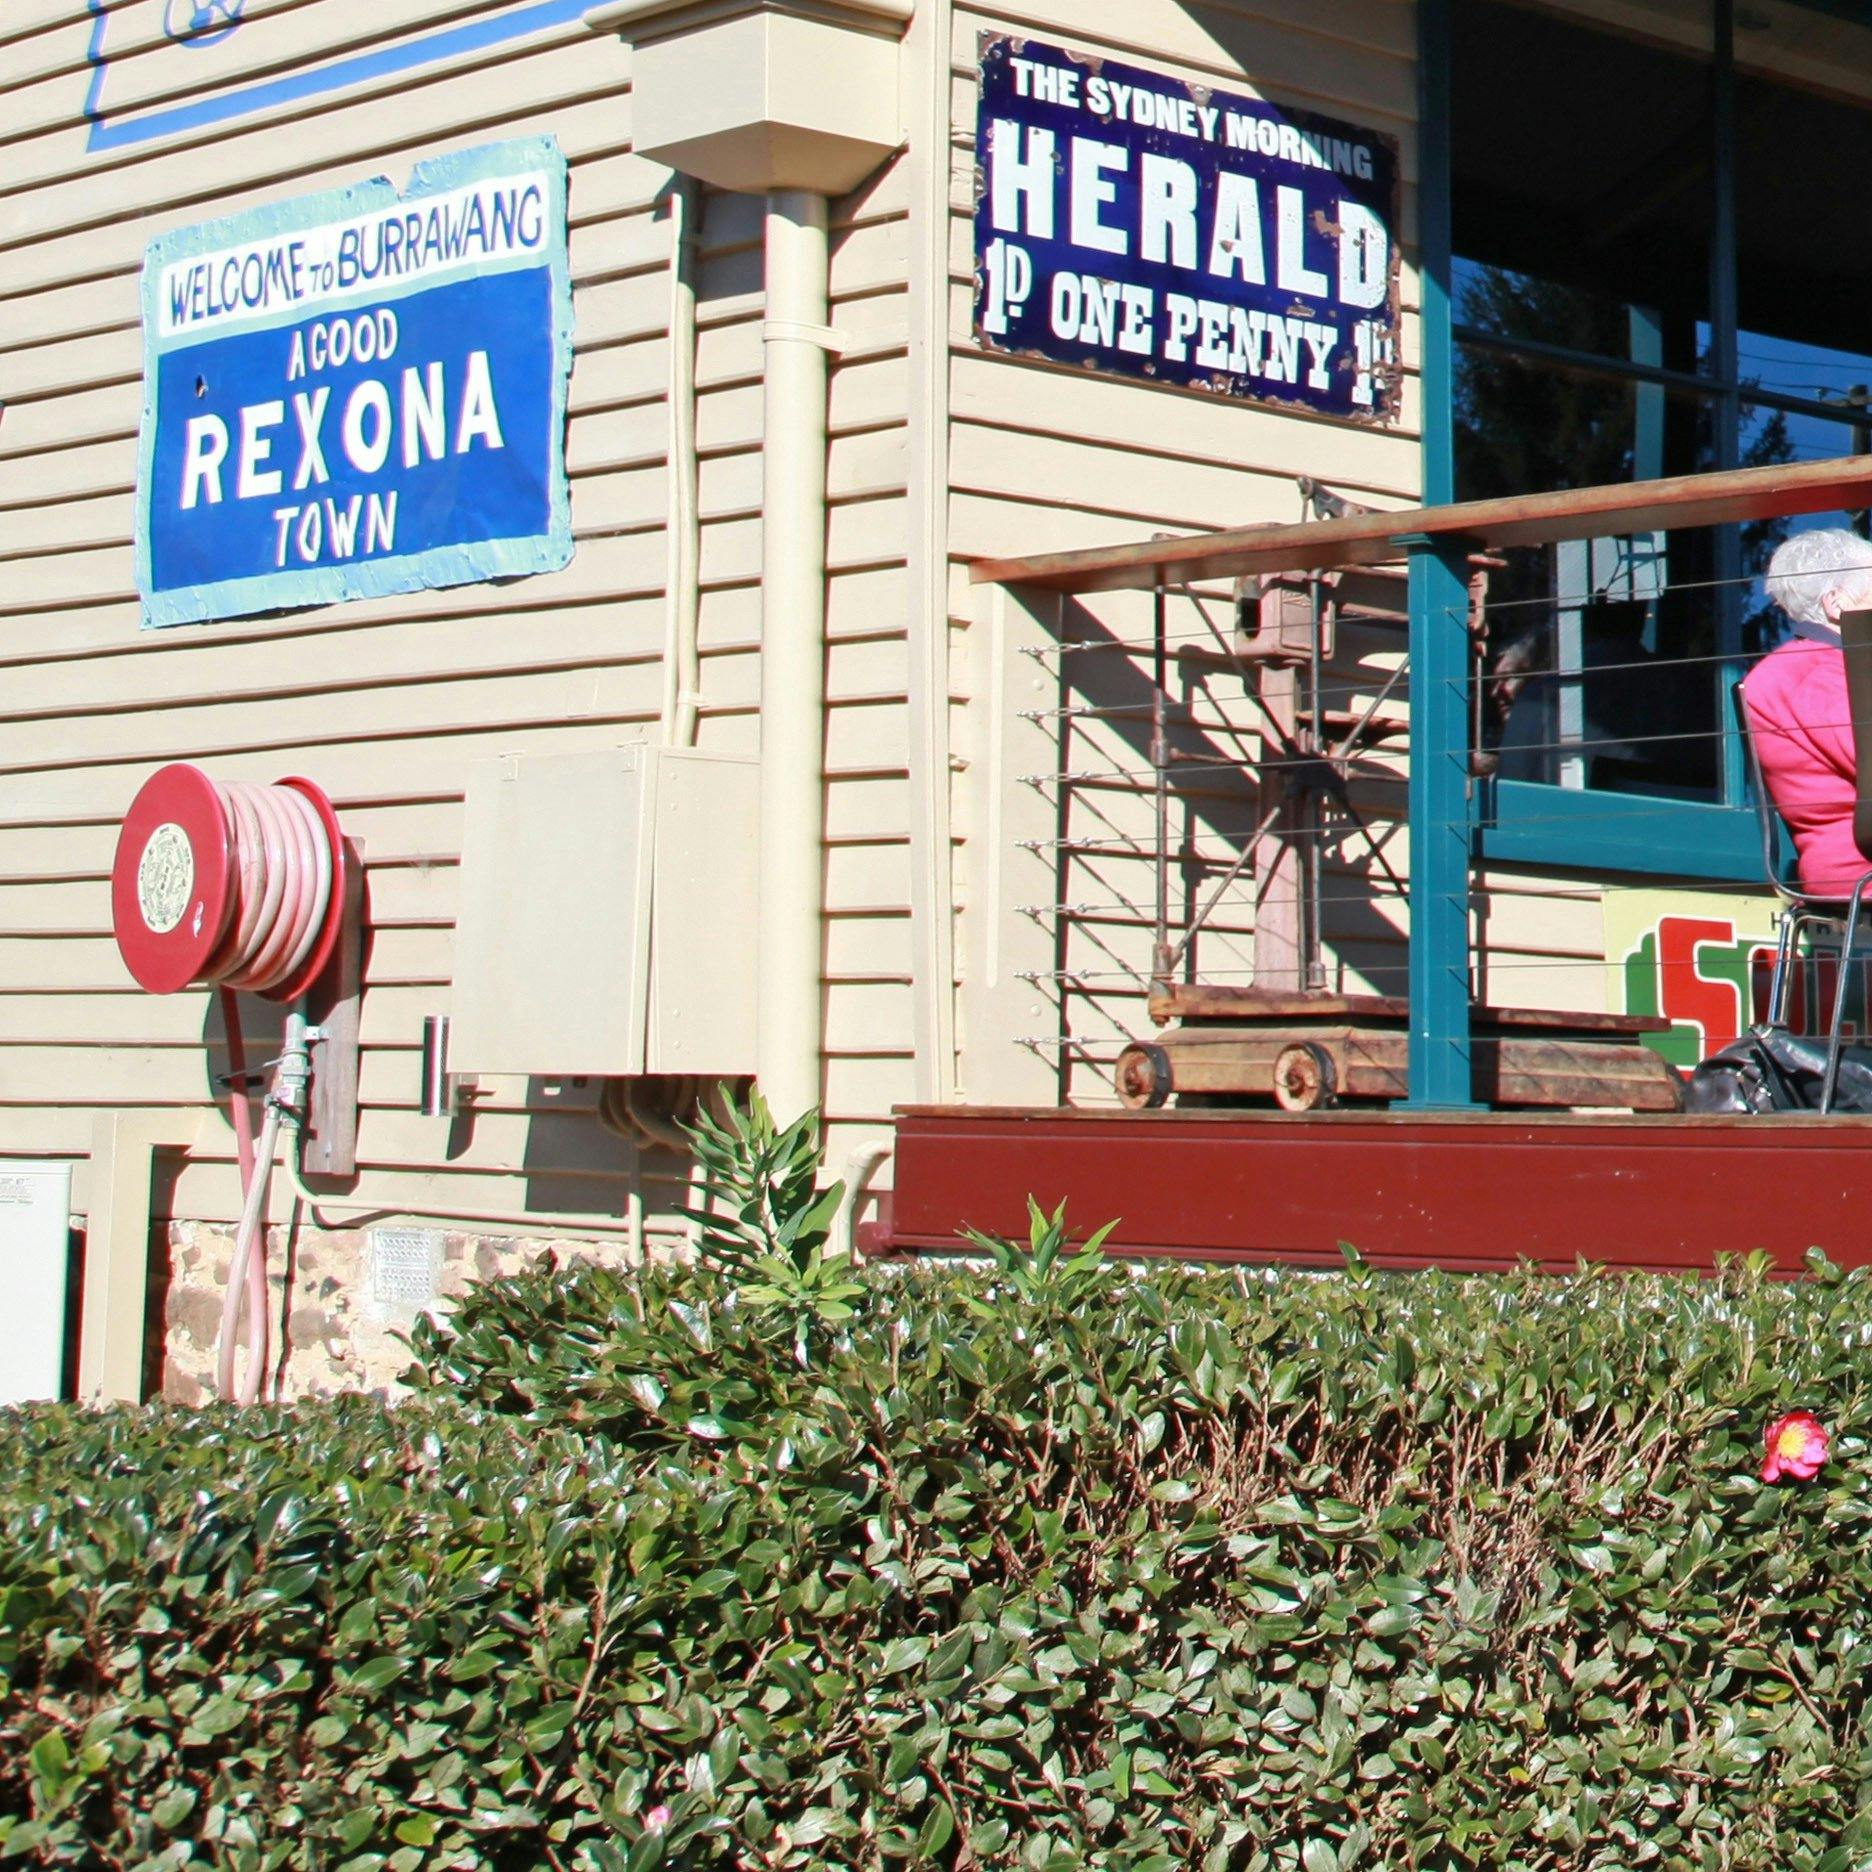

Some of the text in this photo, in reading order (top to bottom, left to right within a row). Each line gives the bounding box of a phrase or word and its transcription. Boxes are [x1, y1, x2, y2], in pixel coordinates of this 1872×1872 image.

[1010, 58, 1373, 182] THE SYDNEY MORNING
[171, 240, 305, 327] WELCOME
[338, 185, 543, 289] BURRAWANG
[992, 118, 1388, 310] HERALD
[287, 308, 398, 381] A GOOD
[1050, 271, 1153, 356] ONE
[1165, 293, 1338, 392] PENNY
[180, 350, 504, 511] REXONA
[275, 490, 398, 567] TOWN
